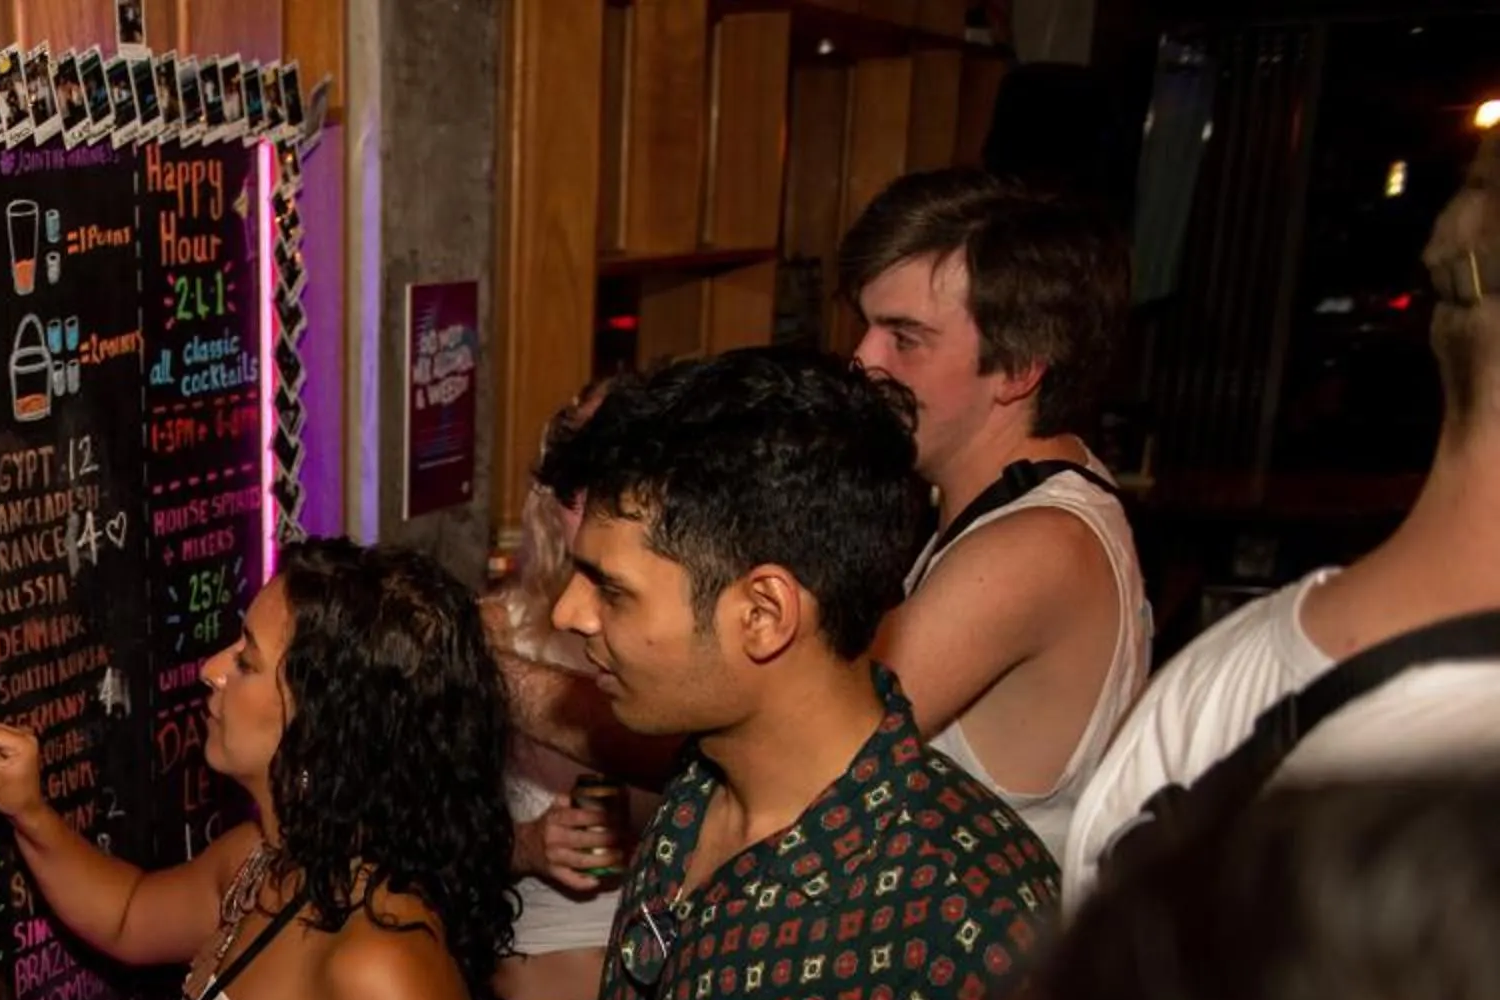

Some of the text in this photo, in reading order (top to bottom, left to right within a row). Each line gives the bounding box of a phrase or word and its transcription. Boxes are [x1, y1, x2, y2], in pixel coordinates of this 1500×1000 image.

[146, 143, 223, 220] Happy
[159, 210, 222, 267] Hour
[182, 328, 241, 367] classic
[150, 348, 260, 398] all cocktails
[152, 499, 209, 538] HOUSE
[188, 564, 232, 612] 25%
[193, 611, 222, 642] off
